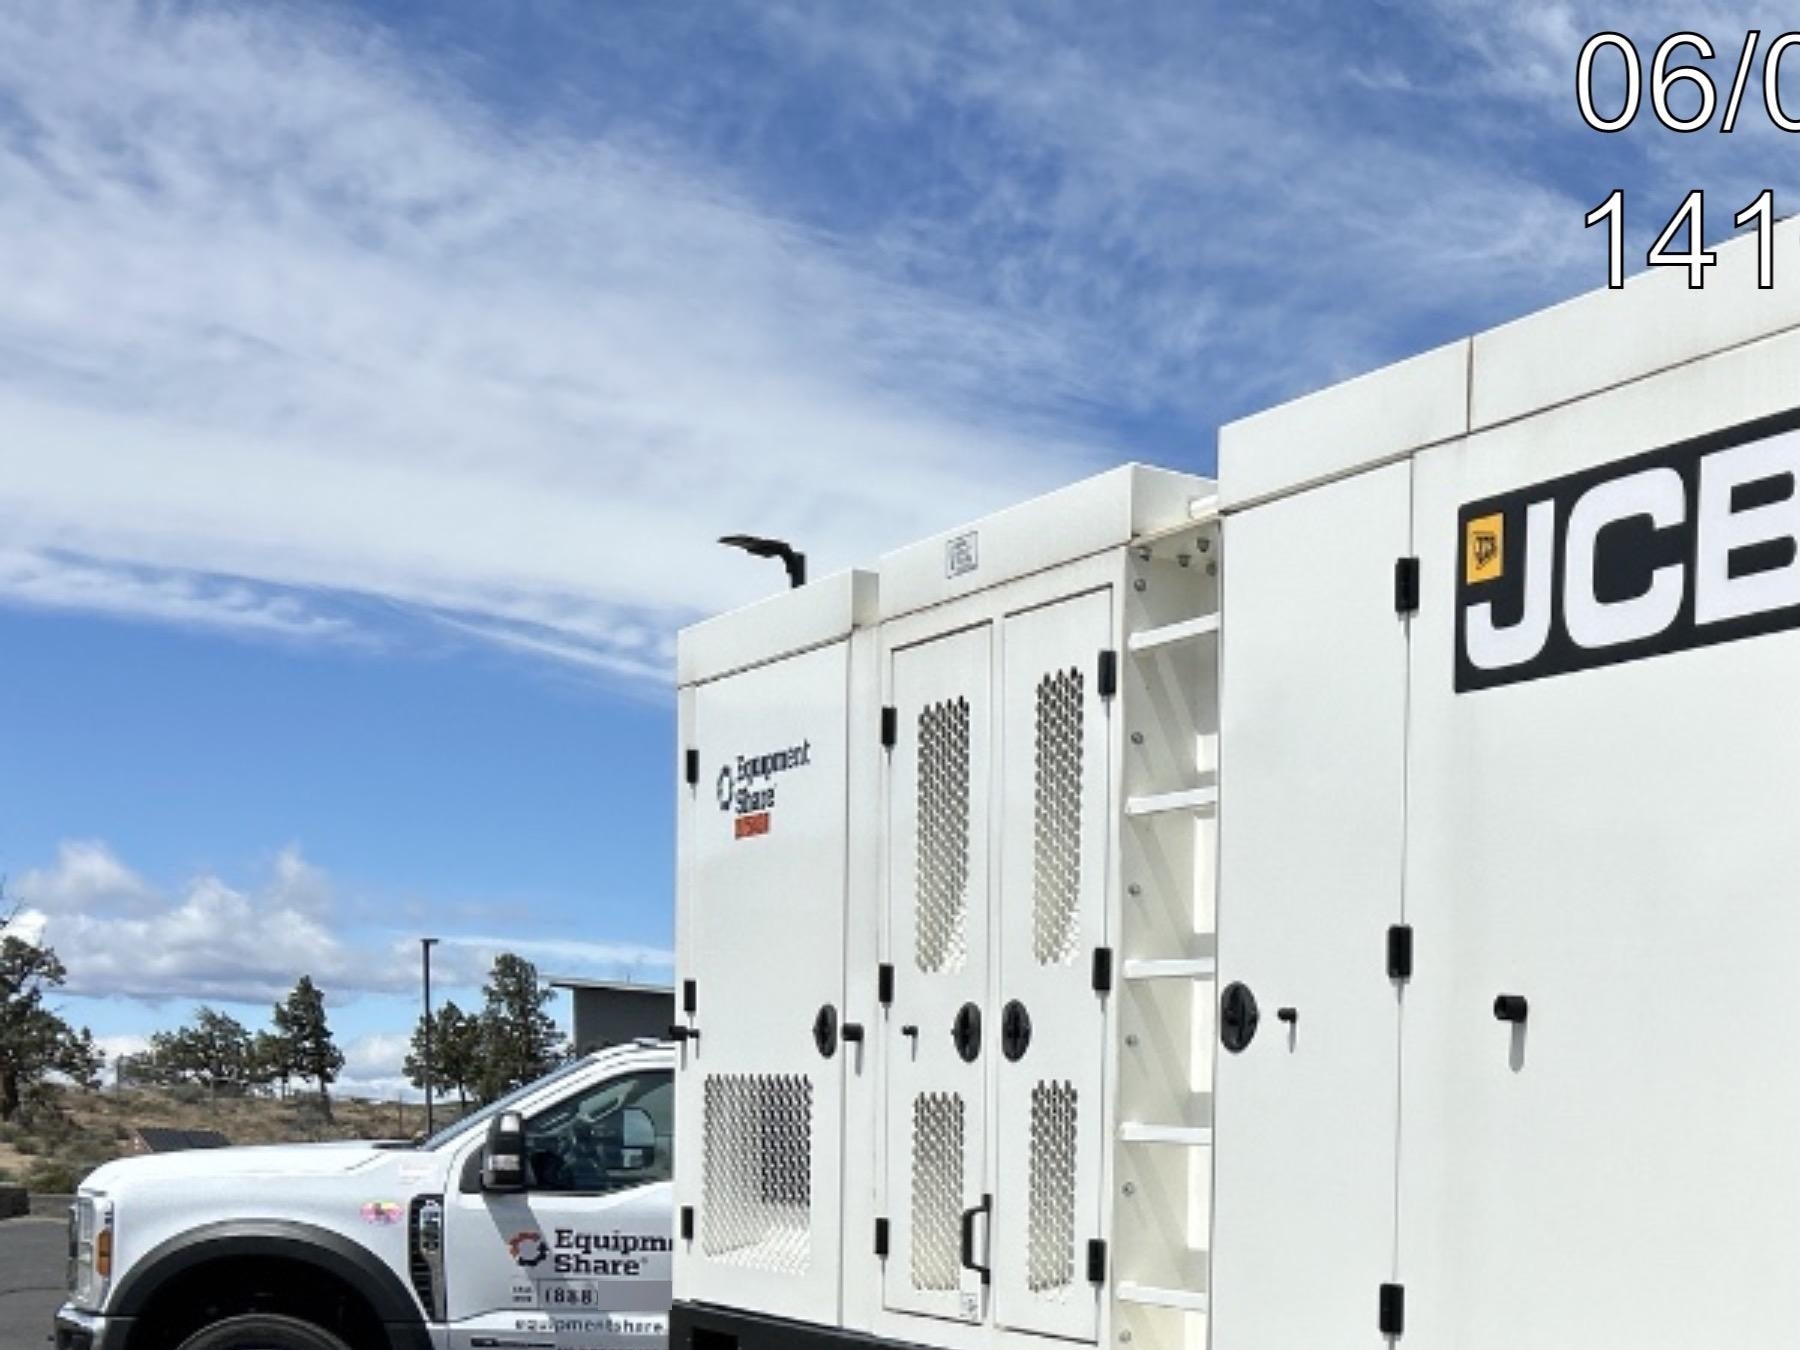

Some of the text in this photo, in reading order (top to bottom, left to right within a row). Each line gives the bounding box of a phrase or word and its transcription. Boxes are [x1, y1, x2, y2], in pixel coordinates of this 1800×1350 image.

[735, 787, 776, 814] Share
[554, 1228, 673, 1255] Equipm
[554, 1254, 640, 1276] Share
